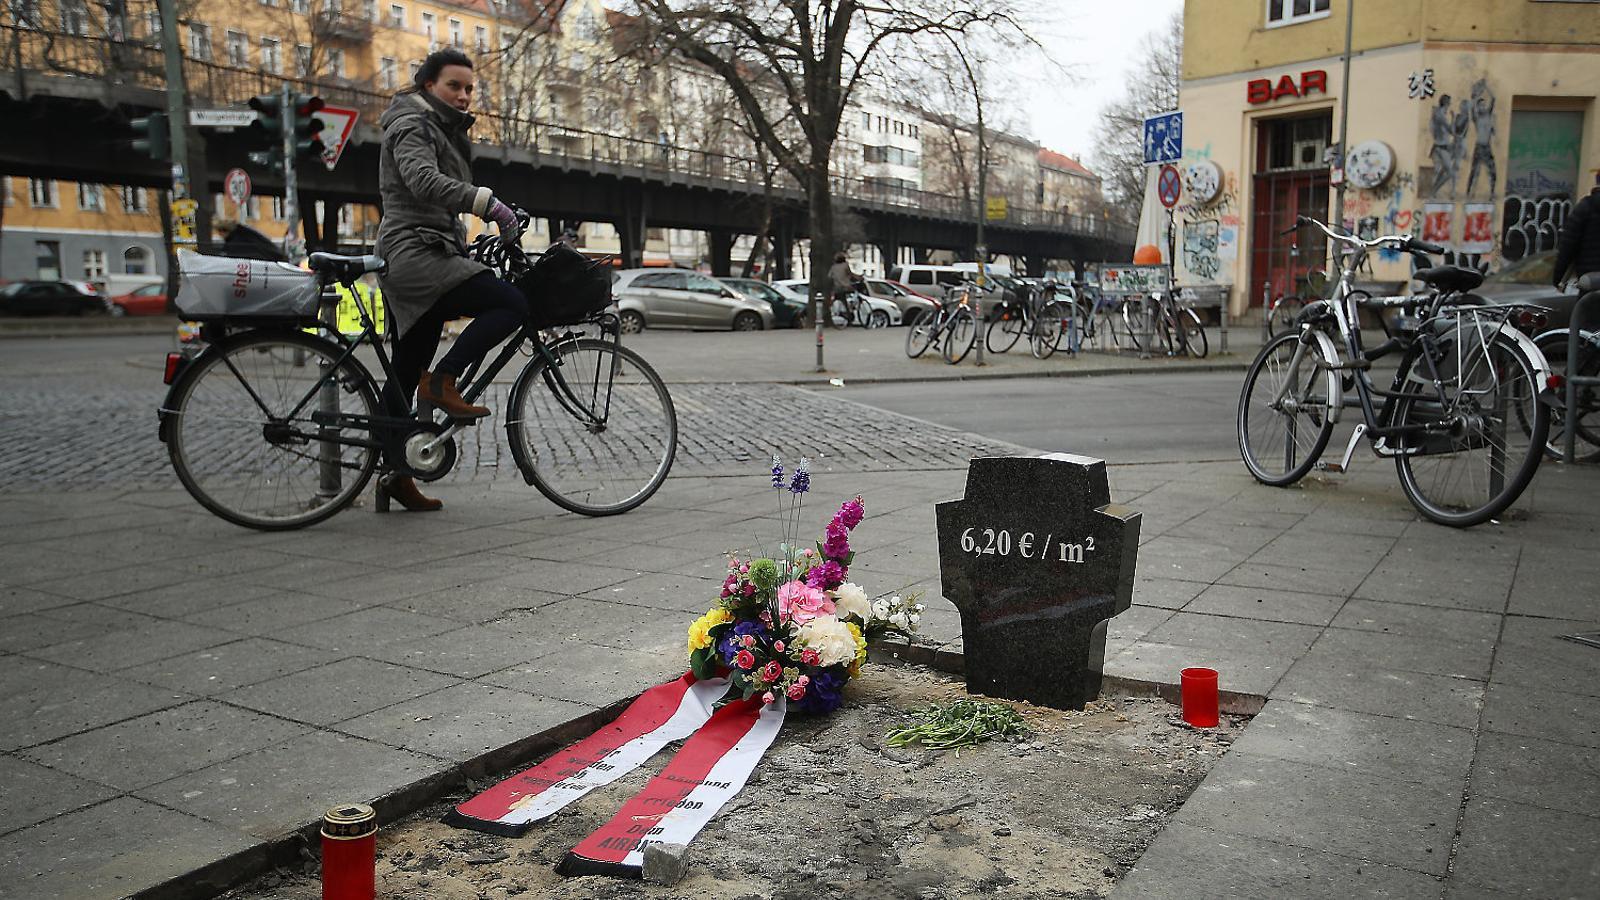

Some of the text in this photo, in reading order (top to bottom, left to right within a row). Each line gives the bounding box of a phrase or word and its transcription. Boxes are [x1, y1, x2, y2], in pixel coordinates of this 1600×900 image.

[1247, 70, 1327, 104] BAR
[960, 527, 1011, 558] 6,20
[1018, 532, 1035, 558] €
[1041, 534, 1052, 560] /
